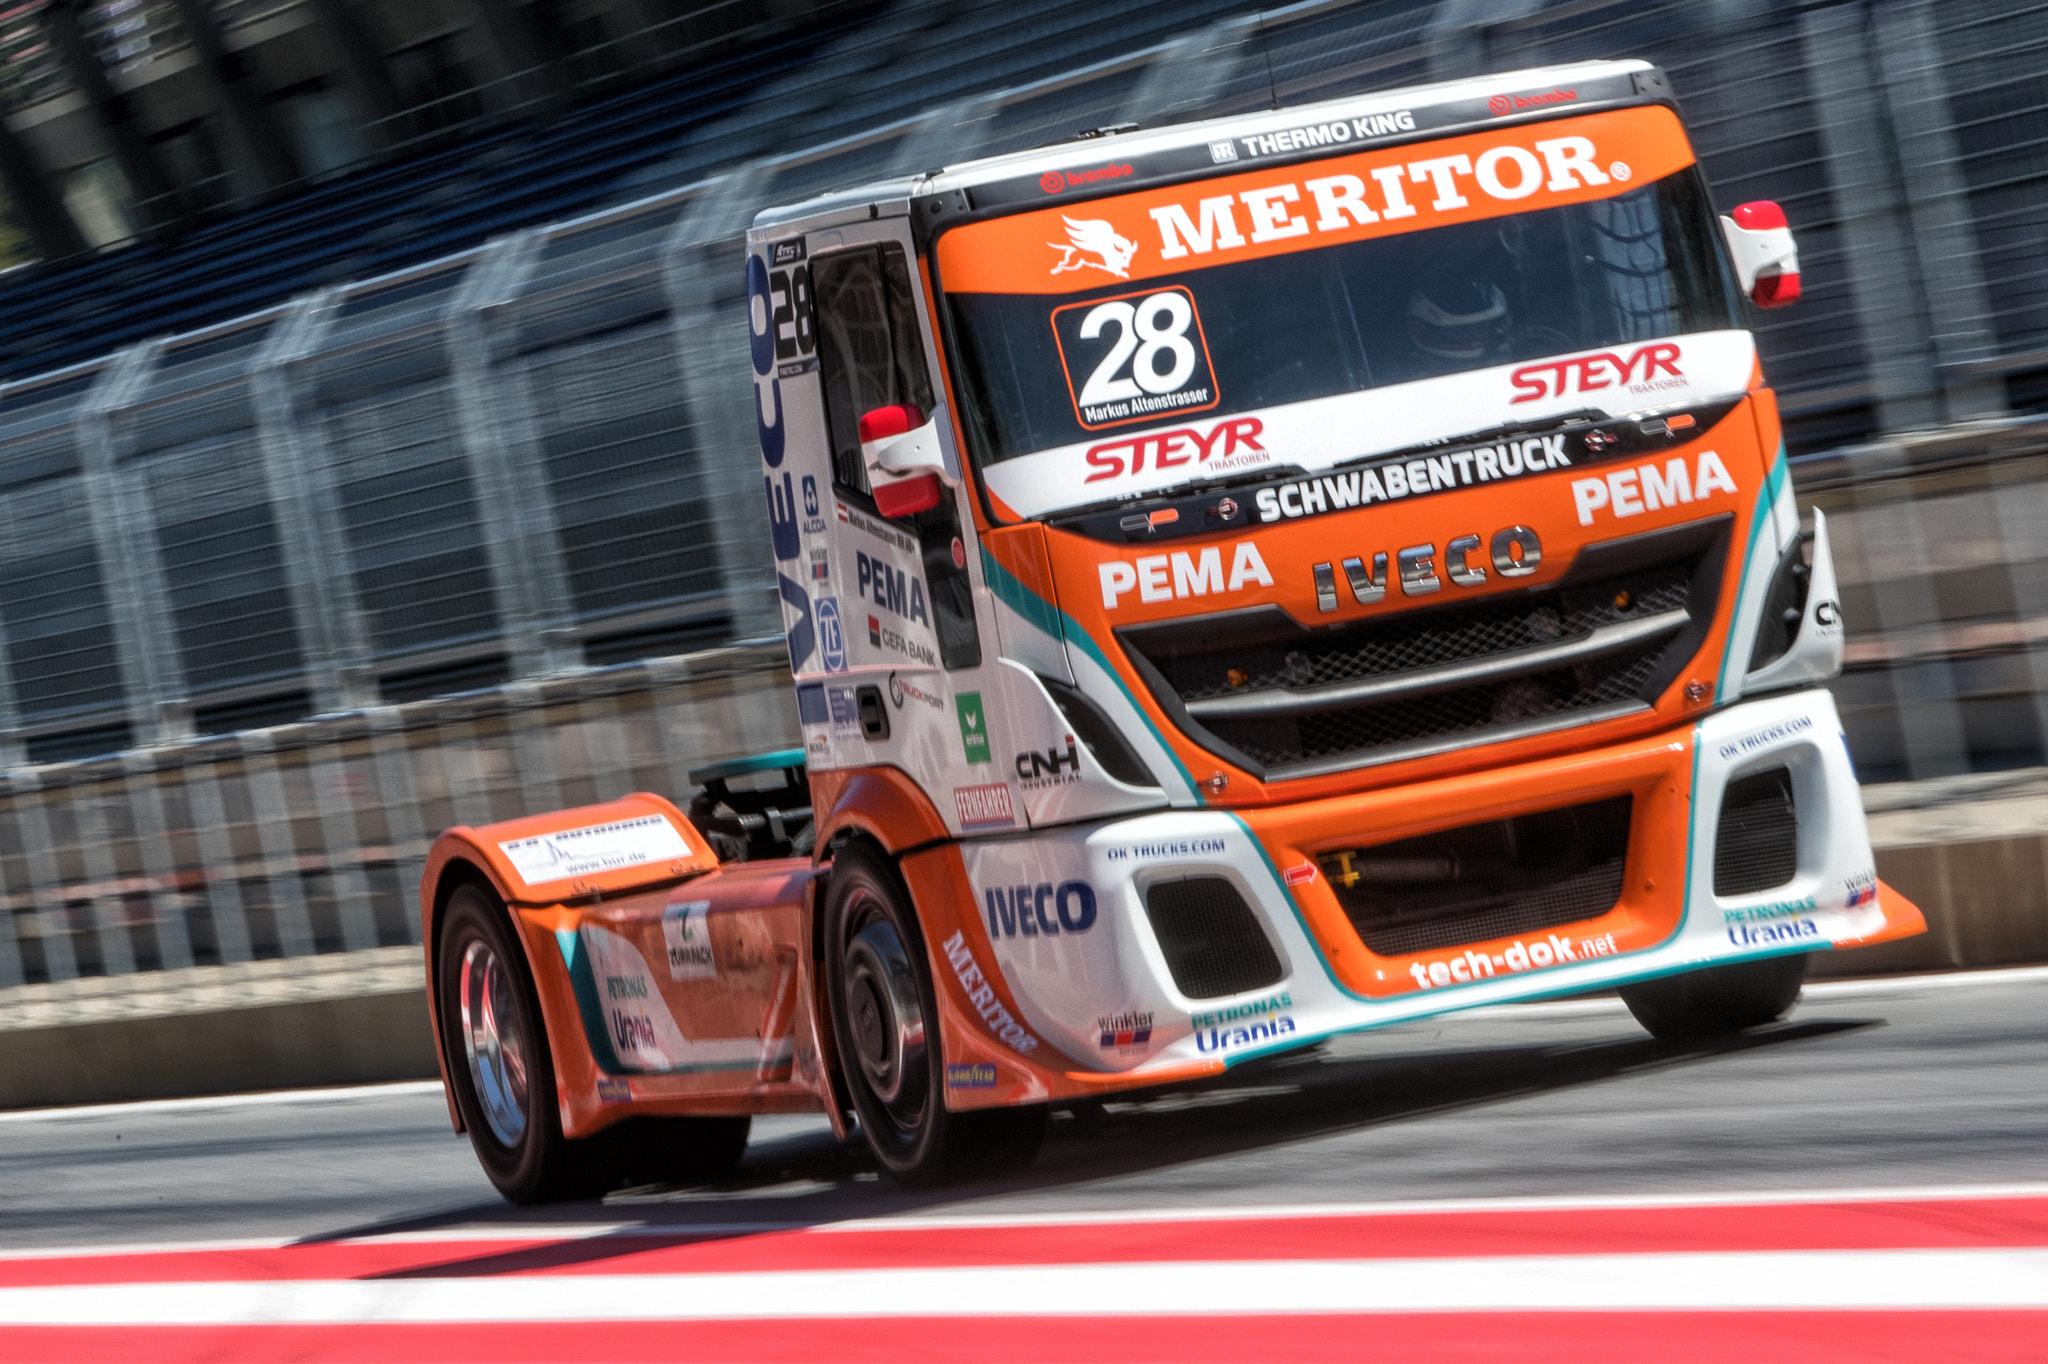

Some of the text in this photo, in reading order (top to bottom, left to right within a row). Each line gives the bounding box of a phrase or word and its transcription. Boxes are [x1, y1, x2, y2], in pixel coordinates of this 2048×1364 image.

[1512, 88, 1578, 109] brembo
[1241, 110, 1416, 156] THERMO KING
[1066, 163, 1133, 187] brembo
[1149, 136, 1610, 260] MERITOR
[769, 263, 815, 360] 28
[1078, 292, 1197, 407] 28
[1508, 343, 1684, 404] STEYR
[1628, 377, 1690, 396] TRAKTOREN
[1085, 388, 1209, 423] Markus Altenstrasser
[1085, 417, 1266, 483] STEYR
[1208, 451, 1271, 473] TRAKTOREN
[1255, 434, 1572, 522] SCHWABENTRUCK
[1571, 450, 1739, 526] PEMA
[803, 518, 828, 535] ALCOA
[856, 550, 929, 629] PEMA
[1098, 541, 1275, 610] PEMA
[1312, 524, 1542, 613] IVECO
[820, 616, 842, 656] ZF
[882, 628, 936, 667] GEFA BANK
[1015, 733, 1080, 779] CNH
[1720, 742, 1740, 760] OK
[1107, 838, 1226, 861] OK TRUCKS.COM
[985, 880, 1097, 940] IVECO
[1724, 896, 1818, 925] PETRONAS
[1726, 914, 1819, 948] Urania
[1409, 932, 1617, 990] tech-dok.net
[607, 975, 648, 1000] PETRONAS
[942, 928, 1039, 1056] MERITOR
[613, 1005, 657, 1051] Urania
[1098, 1011, 1154, 1031] winkler
[1191, 991, 1293, 1032] PETRONAS
[1196, 1012, 1297, 1055] Urania
